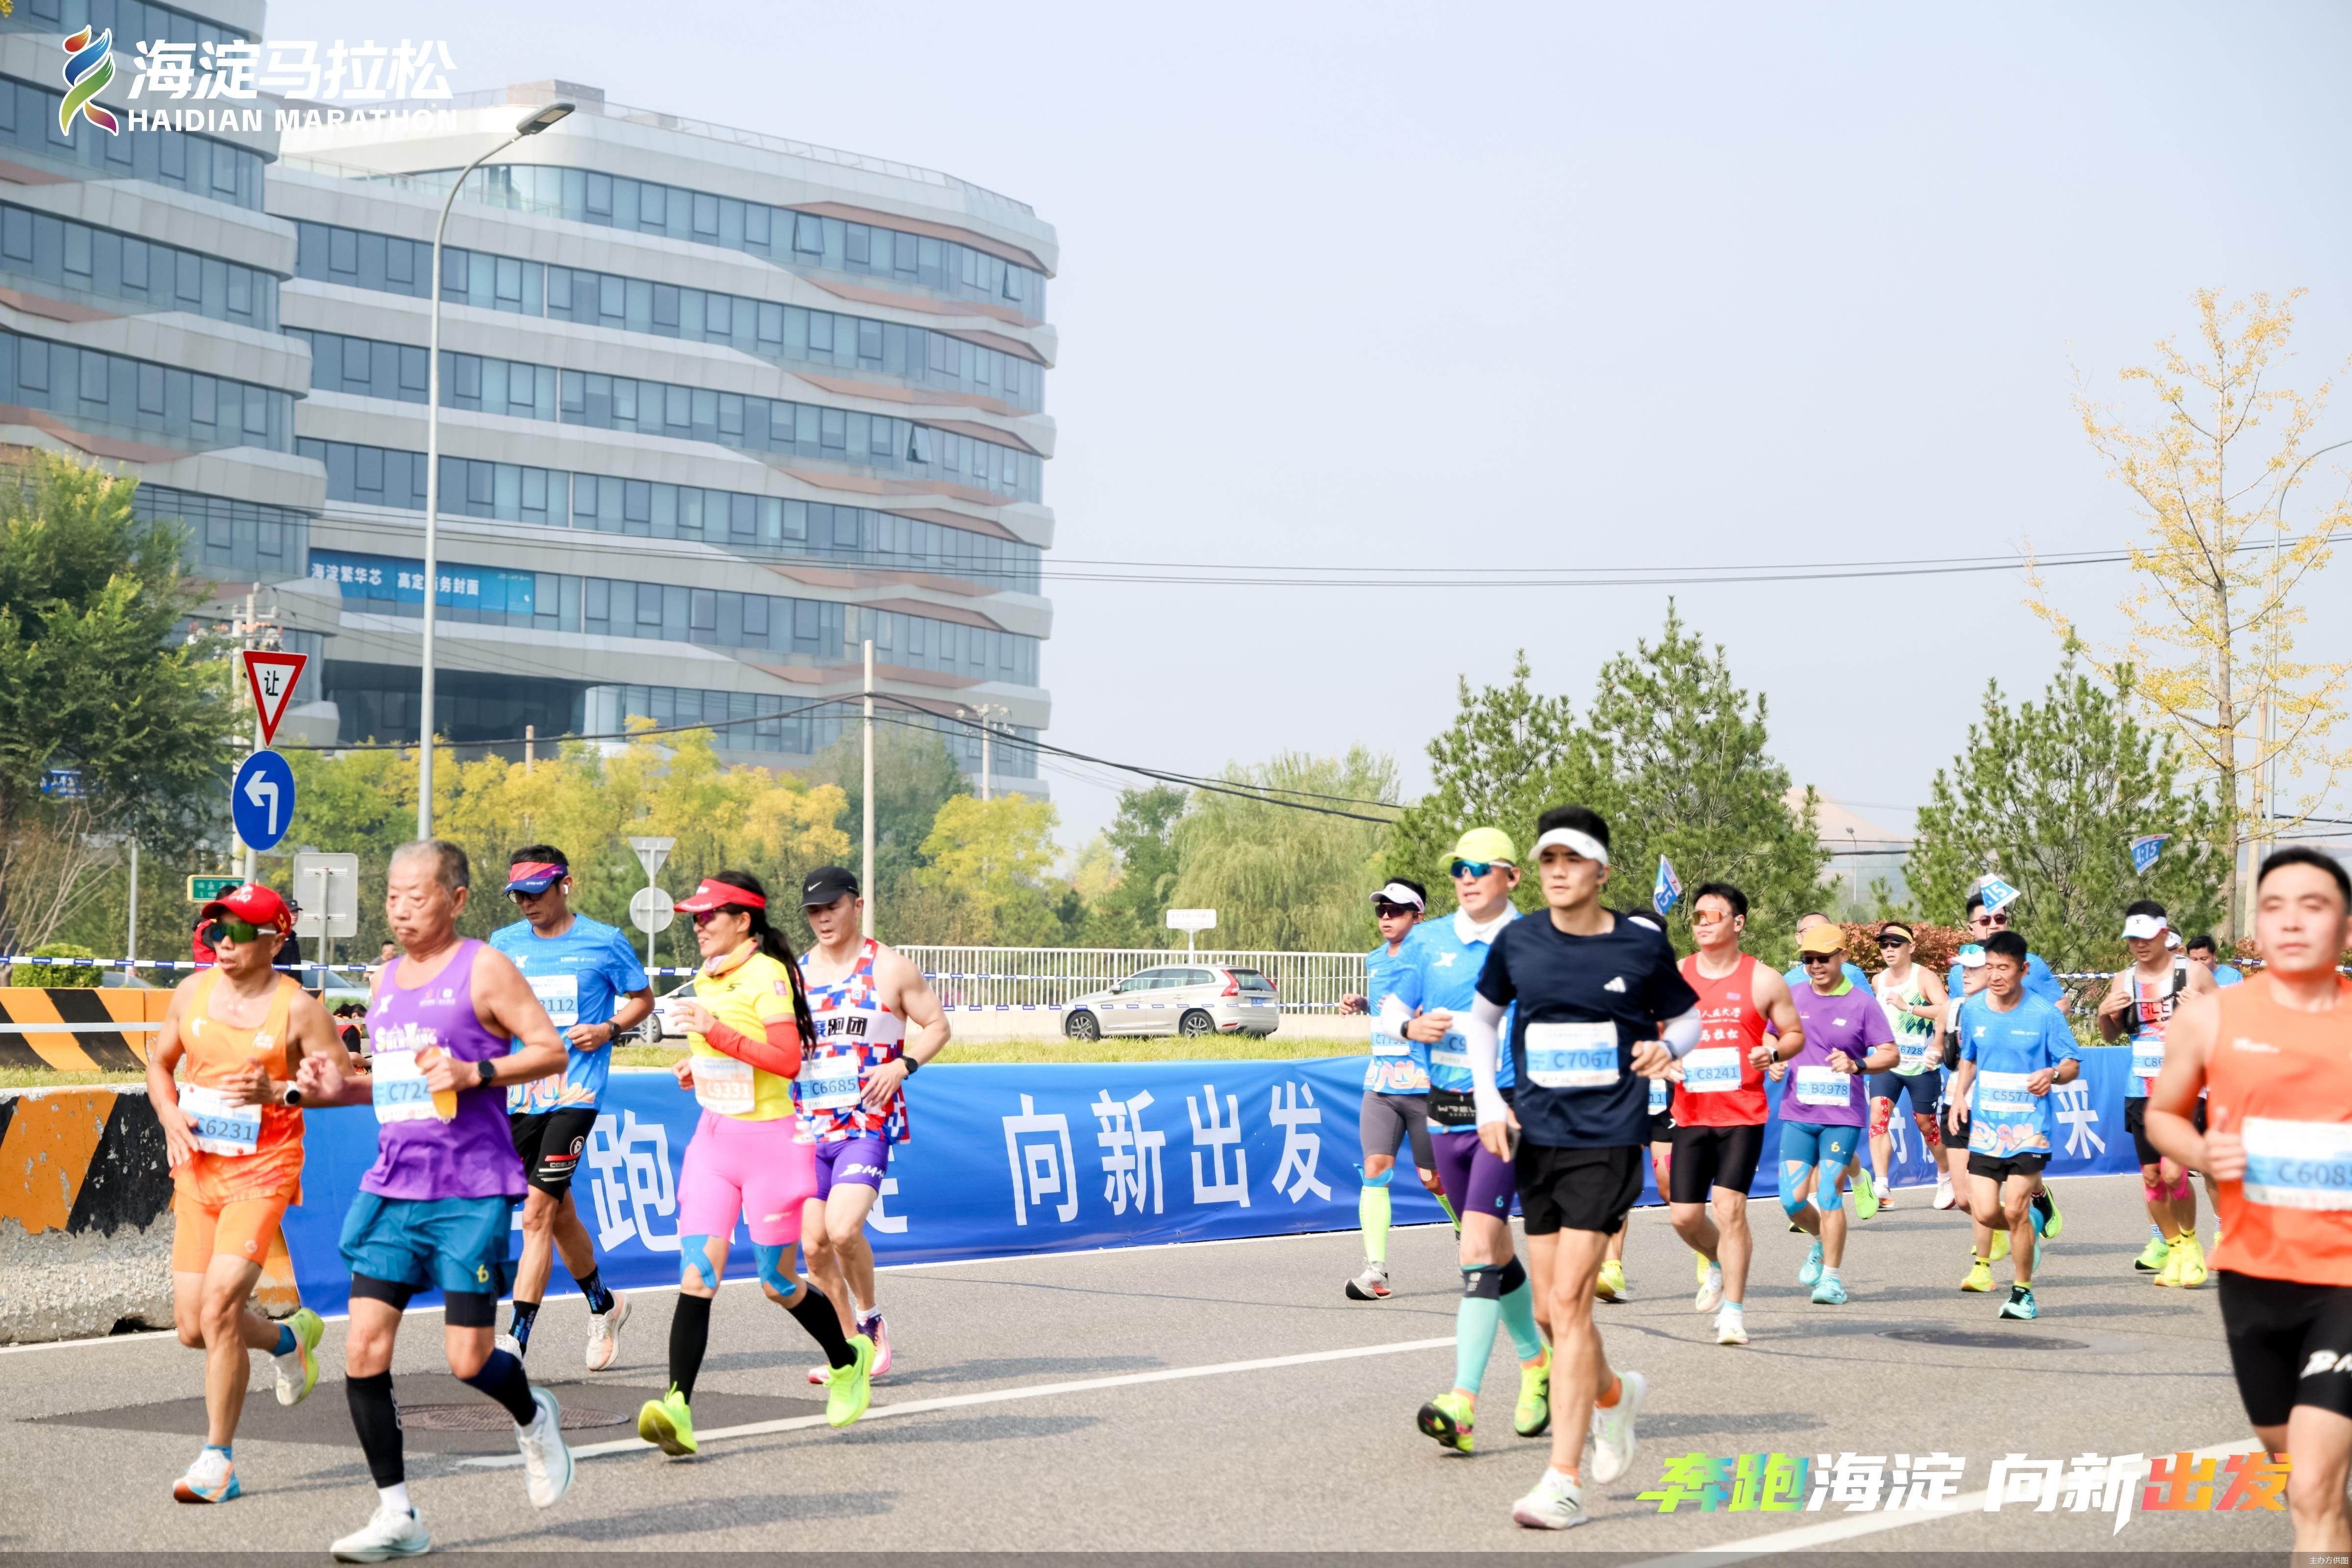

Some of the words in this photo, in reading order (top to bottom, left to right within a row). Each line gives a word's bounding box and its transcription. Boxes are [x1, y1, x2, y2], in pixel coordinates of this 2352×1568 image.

[264, 670, 279, 696] 让
[2136, 841, 2158, 864] 4:15
[1554, 1051, 1614, 1068] C7067
[1697, 1068, 1738, 1080] C8241
[707, 1081, 750, 1098] C9331
[812, 1079, 856, 1095] C6685
[1812, 1084, 1848, 1095] B2978
[1992, 1090, 2031, 1102] C5577
[1002, 1081, 1331, 1226] 向新出发
